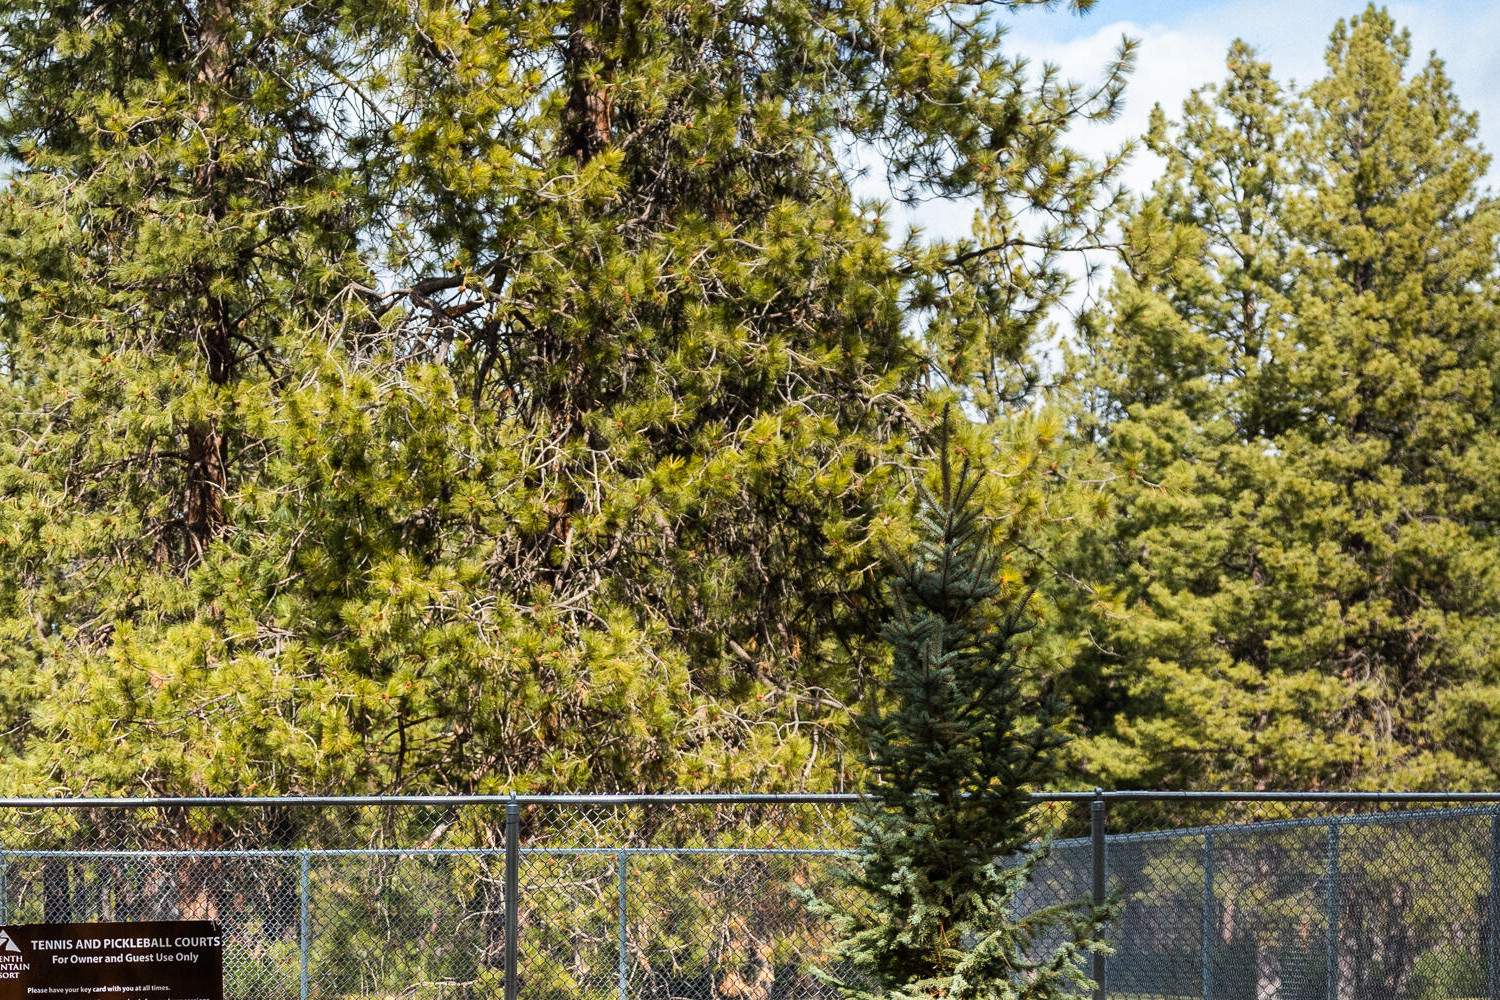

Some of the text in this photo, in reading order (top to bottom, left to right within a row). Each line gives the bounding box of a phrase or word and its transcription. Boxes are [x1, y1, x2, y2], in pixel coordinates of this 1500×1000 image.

[32, 936, 220, 950] TENNIS AND PICKLEBALL COURTS
[52, 952, 199, 964] For Owner and Guest Use Only
[81, 985, 91, 994] key
